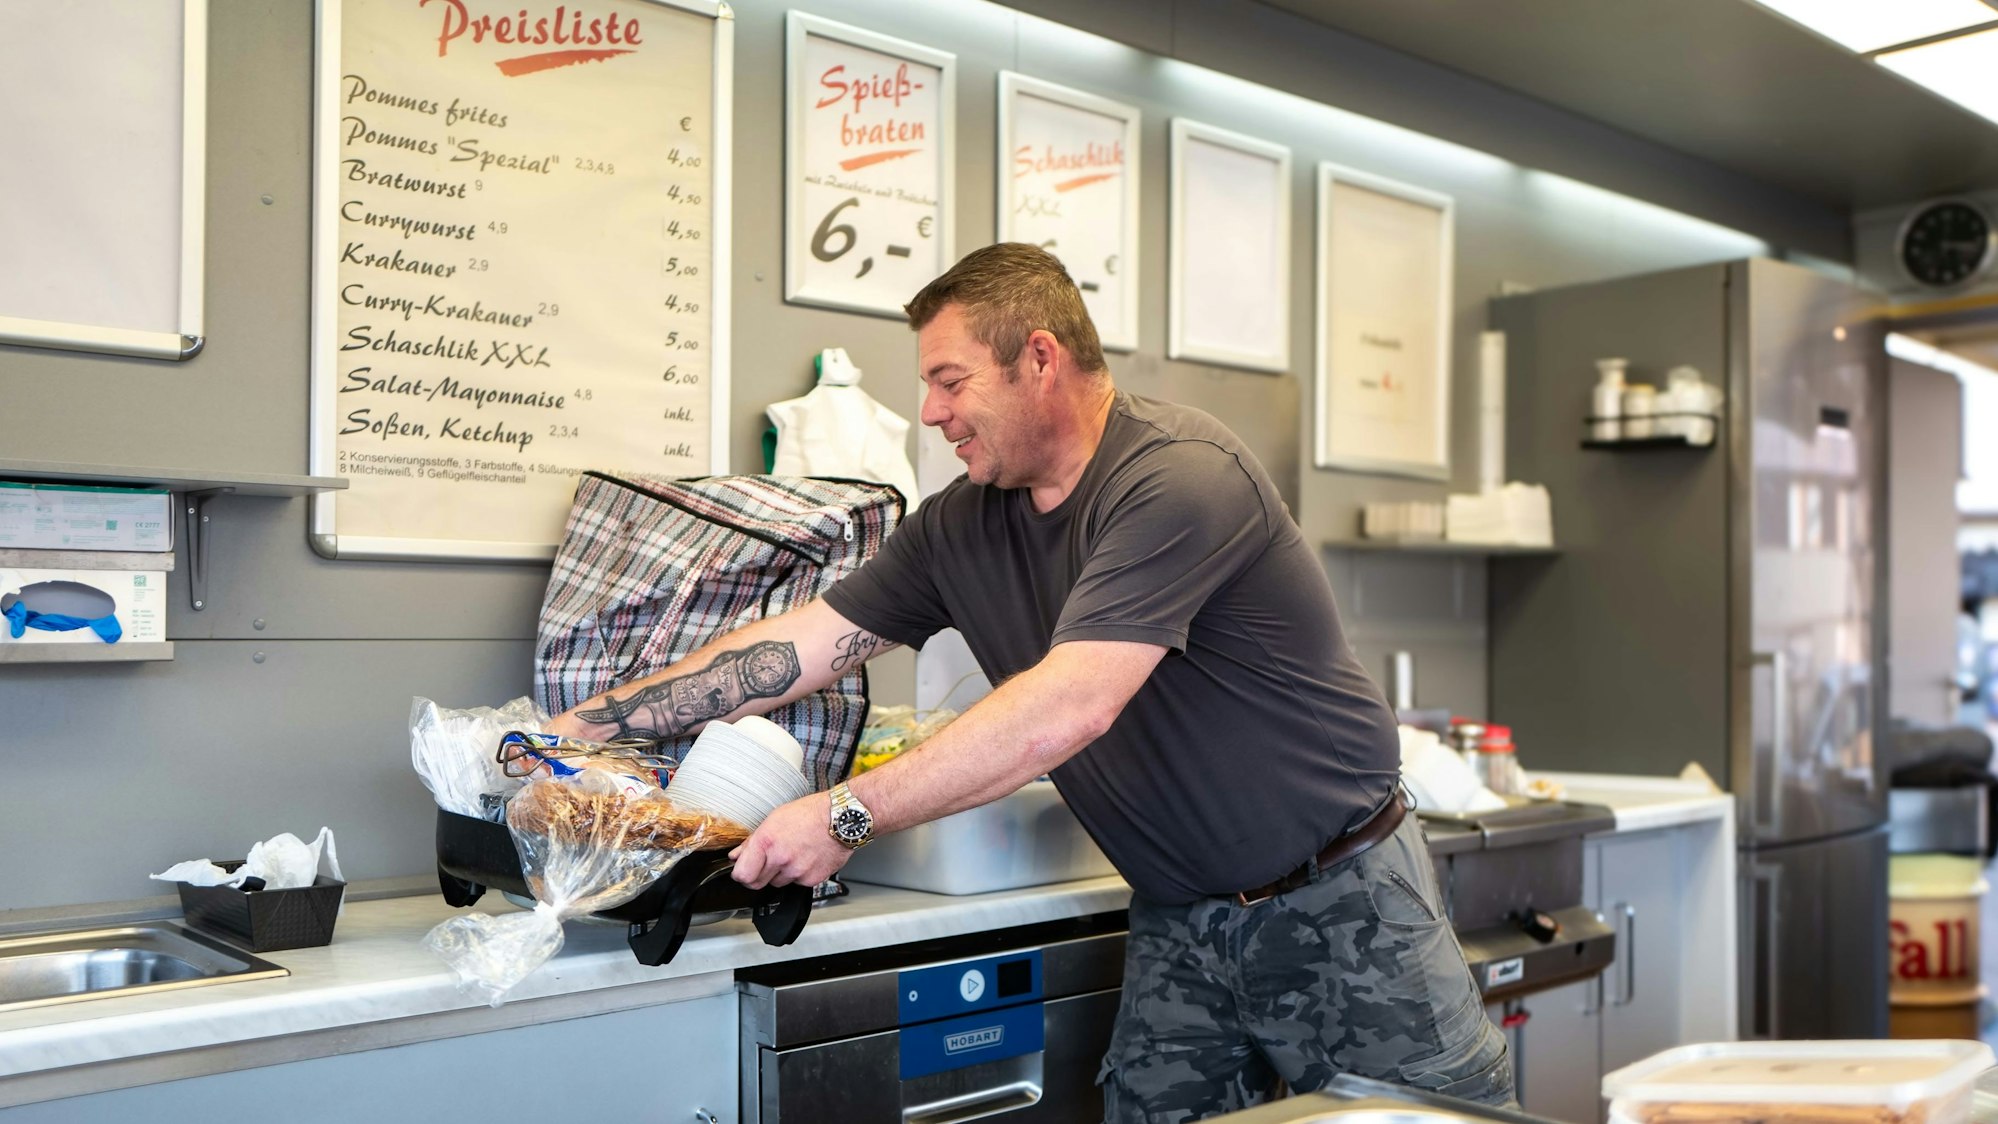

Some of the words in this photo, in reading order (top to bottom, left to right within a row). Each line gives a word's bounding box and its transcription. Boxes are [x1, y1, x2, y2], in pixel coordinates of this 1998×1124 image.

[419, 0, 643, 57] Preisliste
[816, 64, 923, 113] Spieß-
[342, 75, 438, 115] Pommes
[446, 98, 508, 128] frites
[680, 116, 691, 131] €
[841, 114, 924, 146] braten
[342, 116, 438, 155] Pommes
[447, 136, 559, 175] "Spezial"
[575, 157, 615, 175] 2,3,4,8
[667, 148, 701, 167] 4,00
[1014, 140, 1125, 179] Schaschlik
[342, 159, 466, 198] Bratwurst
[474, 179, 483, 191] 9
[667, 184, 701, 204] 4,50
[341, 201, 475, 240] Currywurst
[488, 221, 508, 234] 4,9
[667, 220, 700, 239] 4,50
[917, 216, 933, 238] €
[340, 242, 456, 278] Krakauer
[468, 258, 489, 271] 2,9
[666, 257, 698, 276] 5,00
[341, 284, 533, 328] Curry-Krakauer
[538, 302, 559, 316] 2,9
[664, 294, 699, 313] 4,50
[340, 326, 478, 361] Schaschlik
[480, 340, 551, 369] XXL
[665, 331, 698, 350] 5,00
[663, 365, 698, 384] 6,00
[340, 367, 565, 409] Salat-Mayonnaise
[574, 388, 593, 401] 4,8
[664, 407, 694, 422] inkl.
[339, 409, 430, 441] Soßen,
[440, 417, 533, 453] Ketchup
[549, 425, 579, 438] 2,3,4
[664, 443, 694, 458] inkl.
[339, 451, 346, 461] 2
[350, 451, 461, 469] Konservierungsstoffe,
[465, 459, 471, 469] 3
[474, 460, 526, 473] Farbstoffe,
[528, 464, 535, 473] 4
[339, 464, 346, 473] 8
[350, 464, 414, 478] Milcheiweiß,
[418, 469, 424, 478] 9
[427, 469, 527, 484] Geflügelfleischanteil
[950, 1030, 999, 1048] HOBART
